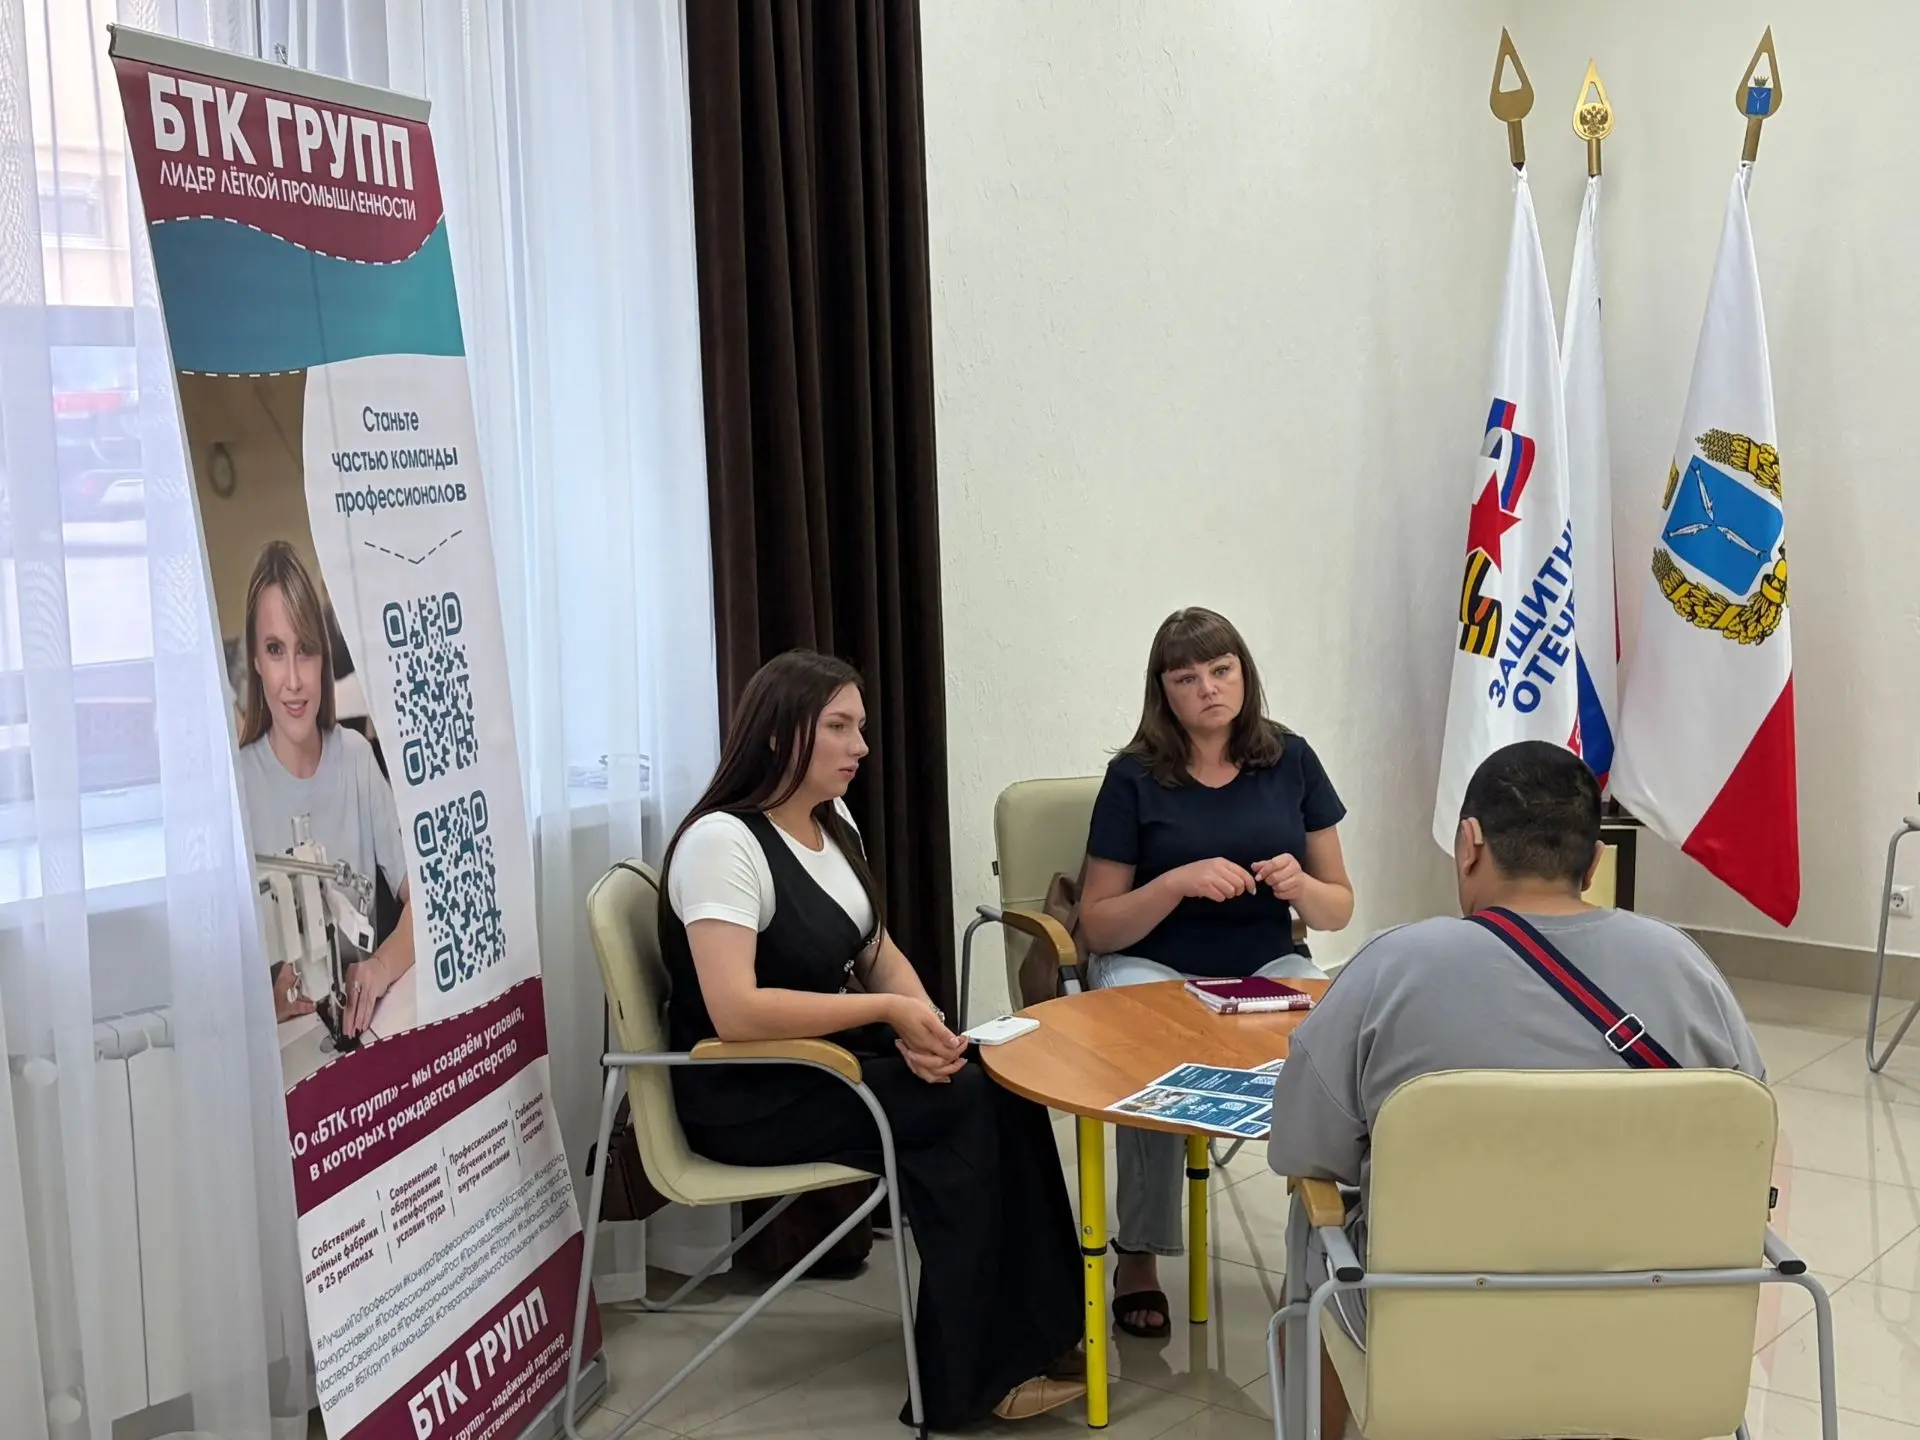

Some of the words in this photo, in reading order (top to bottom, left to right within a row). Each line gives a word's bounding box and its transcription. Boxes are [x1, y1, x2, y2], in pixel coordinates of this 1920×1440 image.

[148, 72, 257, 166] БТК
[265, 97, 414, 190] ГРУПП
[160, 160, 216, 193] ЛИДЕР
[220, 165, 280, 201] ЛЁГКОЙ
[282, 179, 416, 221] ПРОМЫШЛЕННОСТИ
[362, 406, 419, 432] Станьте
[331, 450, 388, 473] частью
[391, 447, 458, 471] команды
[335, 483, 467, 518] профессионалов
[1489, 519, 1571, 708] ЗАЩИТН
[311, 1106, 348, 1146] «БТК
[350, 1085, 399, 1128] групп»
[411, 1064, 431, 1088] мы
[433, 1033, 482, 1075] создаём
[484, 1006, 525, 1050] условия,
[310, 1163, 320, 1181] в
[322, 1122, 386, 1173] которых
[388, 1079, 456, 1140] рождается
[457, 1039, 517, 1089] мастерство
[449, 1118, 508, 1166] Профессиональное
[457, 1150, 487, 1177] обучение
[487, 1147, 492, 1156] и
[492, 1136, 506, 1155] рост
[389, 1162, 438, 1200] Современное
[458, 1171, 480, 1194] внутри
[481, 1149, 510, 1177] компании
[390, 1175, 441, 1216] оборудование
[392, 1222, 398, 1231] и
[399, 1189, 444, 1229] комфортные
[311, 1218, 366, 1260] Собственные
[396, 1219, 426, 1248] условия
[425, 1203, 446, 1228] труда
[305, 1252, 342, 1284] швейные
[343, 1227, 379, 1259] фабрики
[318, 1284, 324, 1294] в
[324, 1272, 336, 1289] 25
[337, 1248, 374, 1283] регионах
[407, 1360, 468, 1440] БТК
[465, 1286, 549, 1391] ГРУПП
[492, 1360, 534, 1411] надёжный
[534, 1332, 565, 1370] партнер
